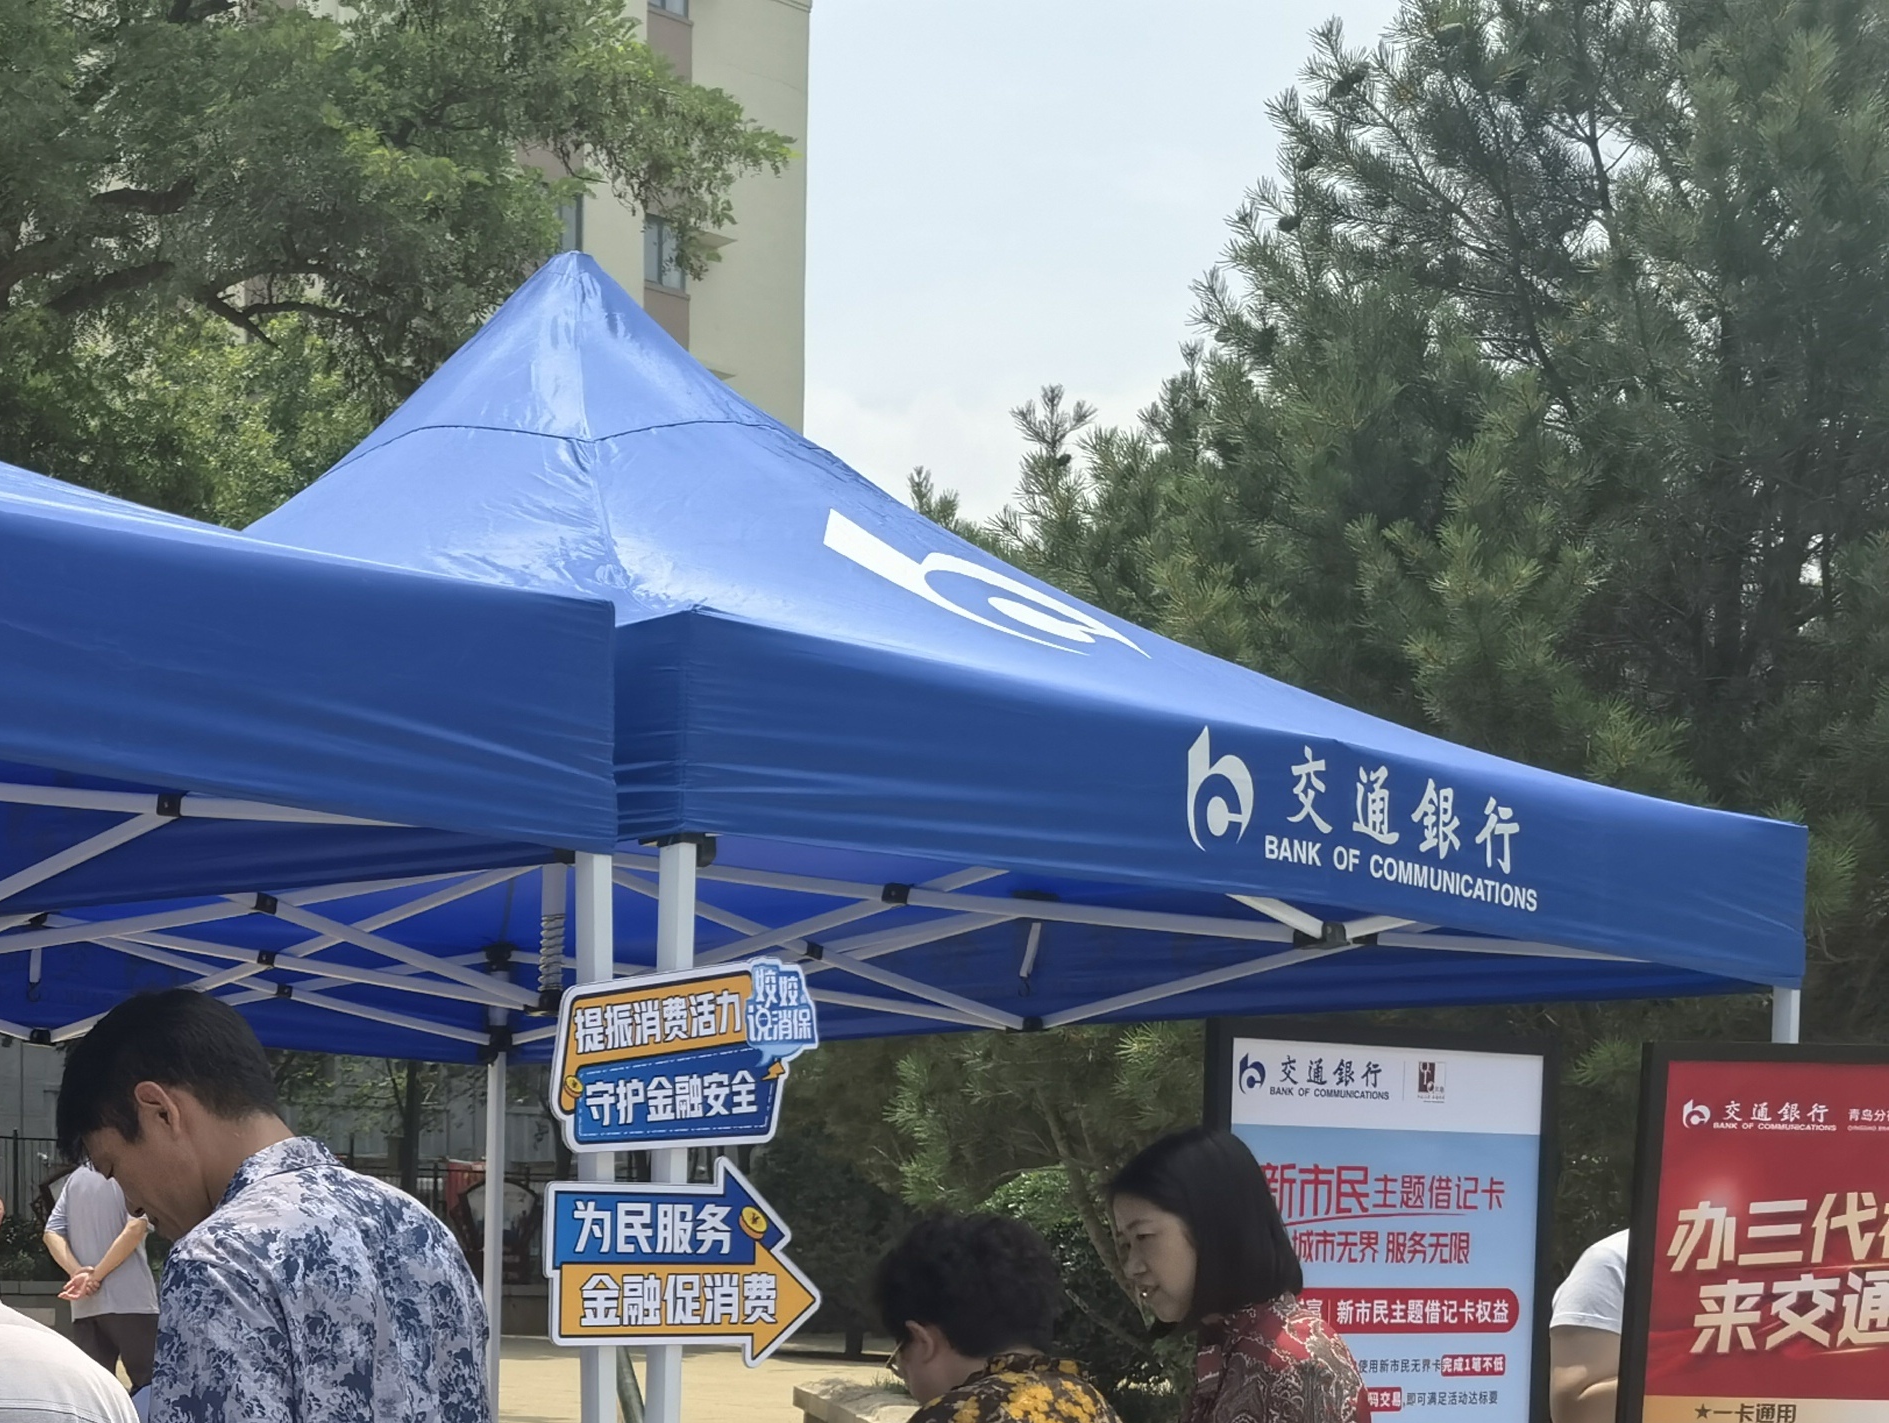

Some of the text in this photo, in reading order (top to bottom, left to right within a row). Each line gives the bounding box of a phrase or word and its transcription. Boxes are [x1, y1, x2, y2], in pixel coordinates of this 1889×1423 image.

[1287, 745, 1521, 875] 交通銀行
[1265, 834, 1538, 912] BANK OF COMMUNICATIONS
[753, 966, 800, 1007] 姣姣
[573, 988, 743, 1055] 提振消费活力
[746, 1004, 813, 1042] 说消保
[1269, 1086, 1390, 1101] BANK OF COMMUNICATIONS
[1279, 1055, 1383, 1088] 交通銀行
[584, 1069, 759, 1128] 守护金融安全
[1722, 1100, 1889, 1123] 交通銀行 青岛分
[1713, 1121, 1738, 1130] BANK
[1742, 1122, 1754, 1130] OF
[1757, 1122, 1837, 1132] COMMUNICATIONS
[1261, 1162, 1506, 1220] 新市民主题借记卡
[573, 1199, 733, 1255] 为民服务
[1385, 1230, 1471, 1265] 服务无限
[1666, 1191, 1889, 1272] 办三代
[580, 1272, 779, 1327] 金融促消费
[1336, 1299, 1509, 1325] 新市民主题借记卡权益
[1689, 1270, 1889, 1354] 来交通
[1713, 1403, 1797, 1423] 一卡通用
